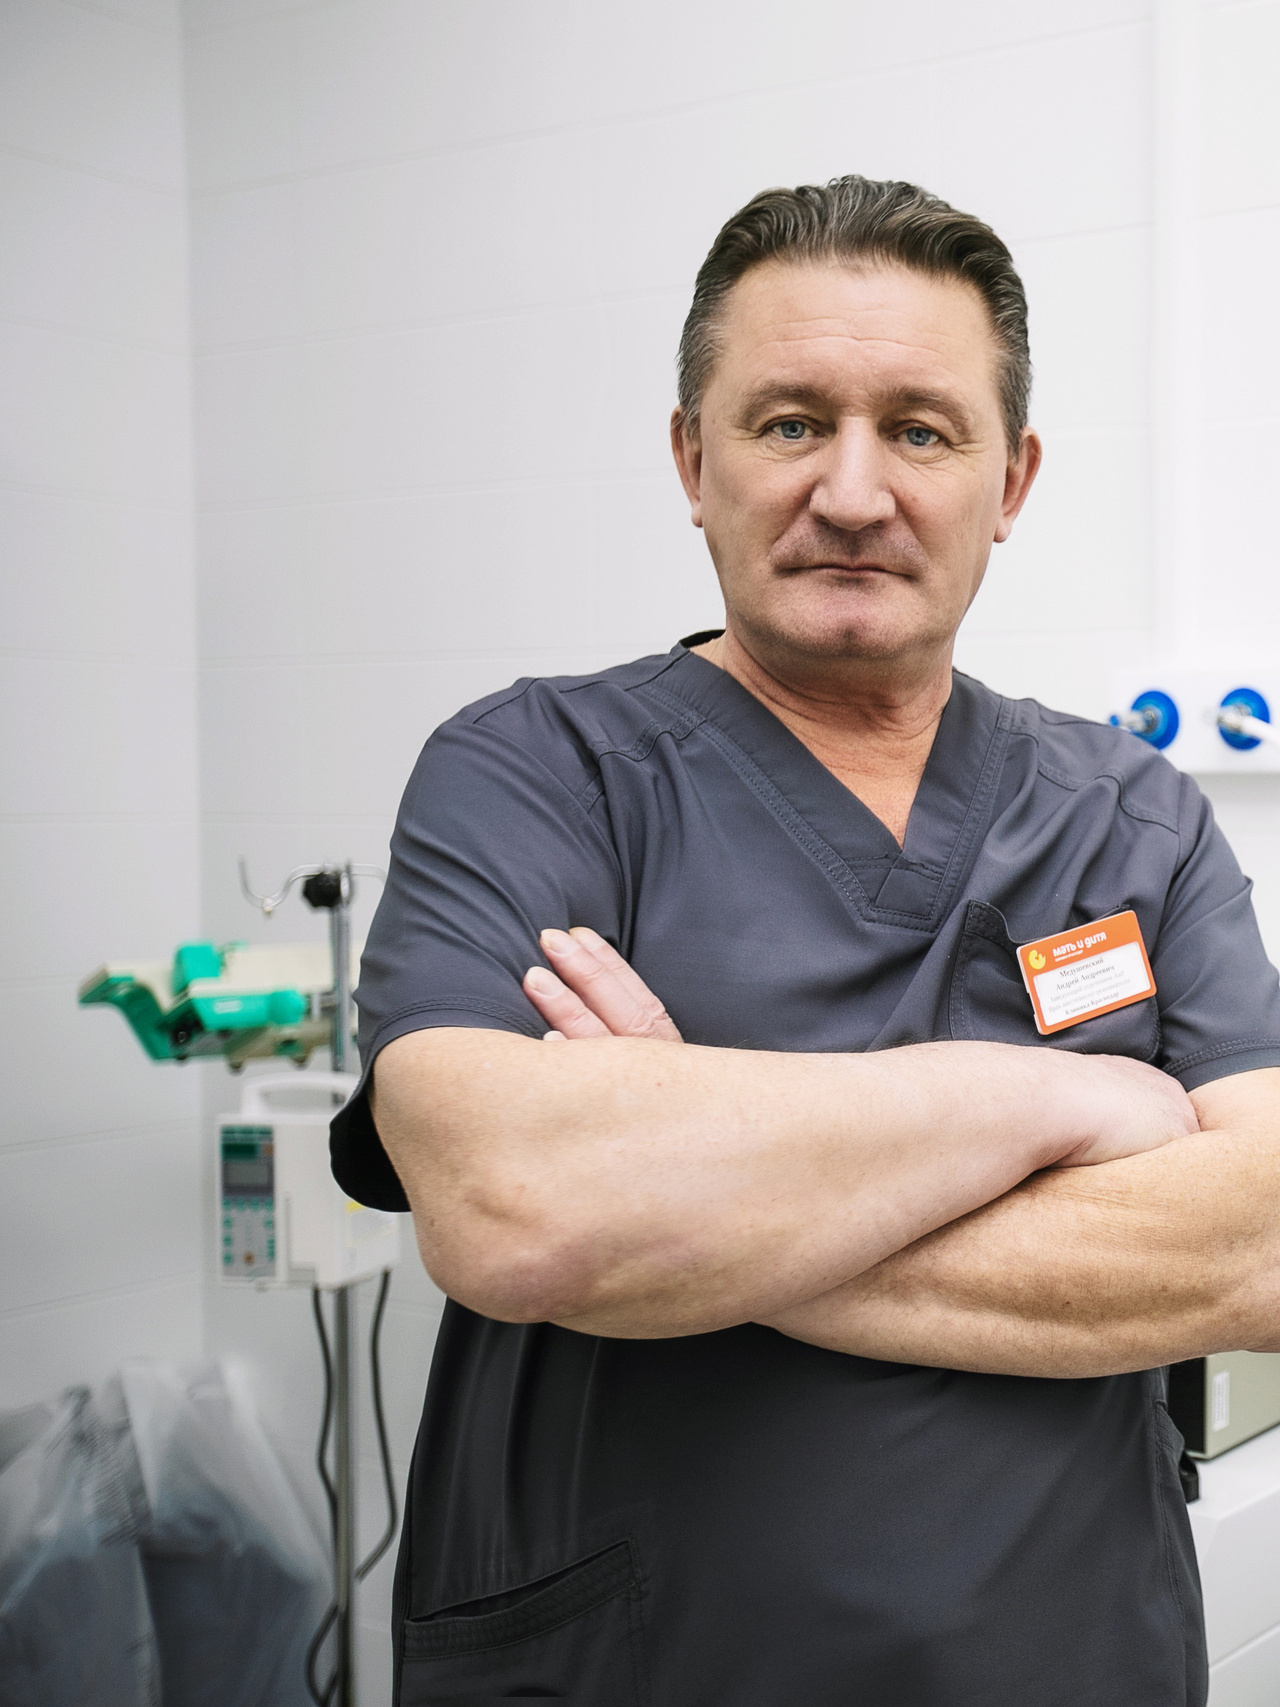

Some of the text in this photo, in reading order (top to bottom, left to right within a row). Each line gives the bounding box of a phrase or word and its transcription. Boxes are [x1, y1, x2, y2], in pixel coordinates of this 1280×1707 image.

[1056, 965, 1115, 991] Андрей Андреевич
[1059, 957, 1104, 978] Медушевский
[1065, 991, 1120, 1015] Клиника Краснодар
